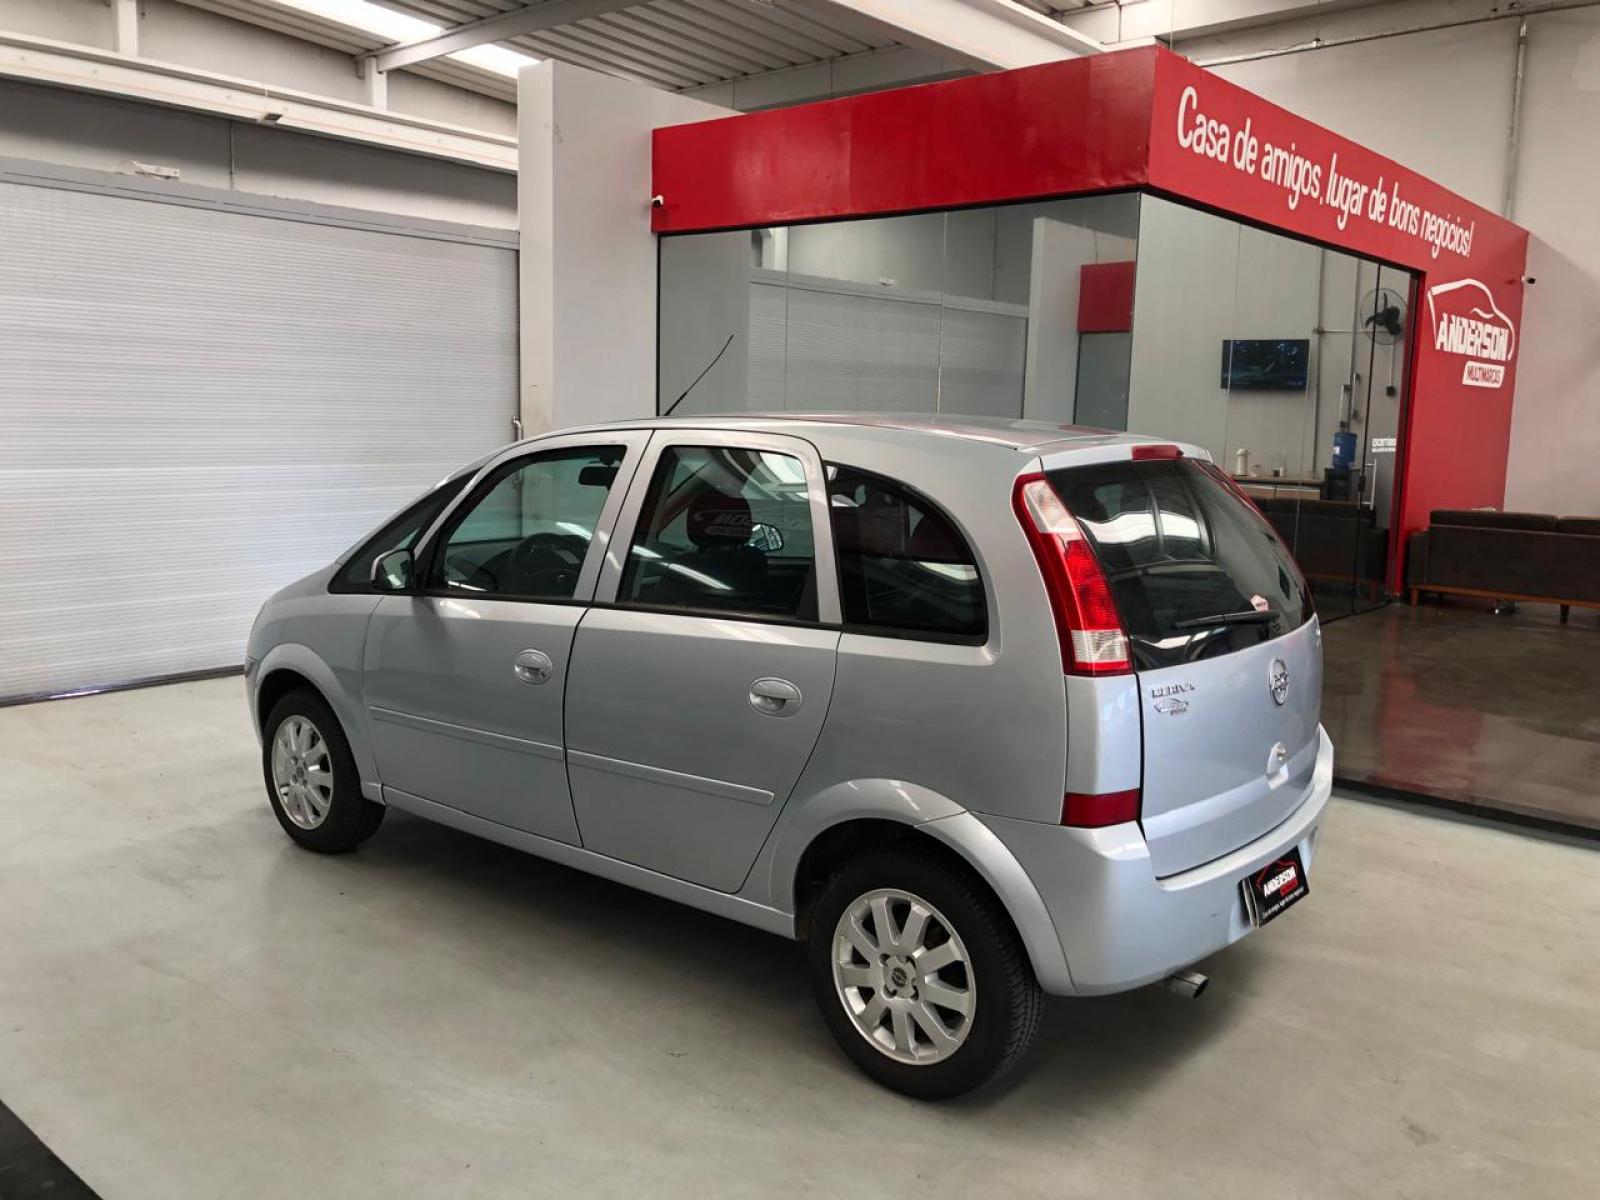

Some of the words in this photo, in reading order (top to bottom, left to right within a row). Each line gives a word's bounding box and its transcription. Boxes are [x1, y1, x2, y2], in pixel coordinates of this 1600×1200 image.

[1177, 86, 1230, 162] Casa
[1233, 118, 1258, 174] de
[1261, 144, 1323, 210] amigos,
[1325, 154, 1367, 230] lugar
[1369, 177, 1386, 221] de
[1389, 183, 1419, 236] bons
[1420, 211, 1474, 259] negócios!
[1435, 313, 1509, 361] ANDERSON
